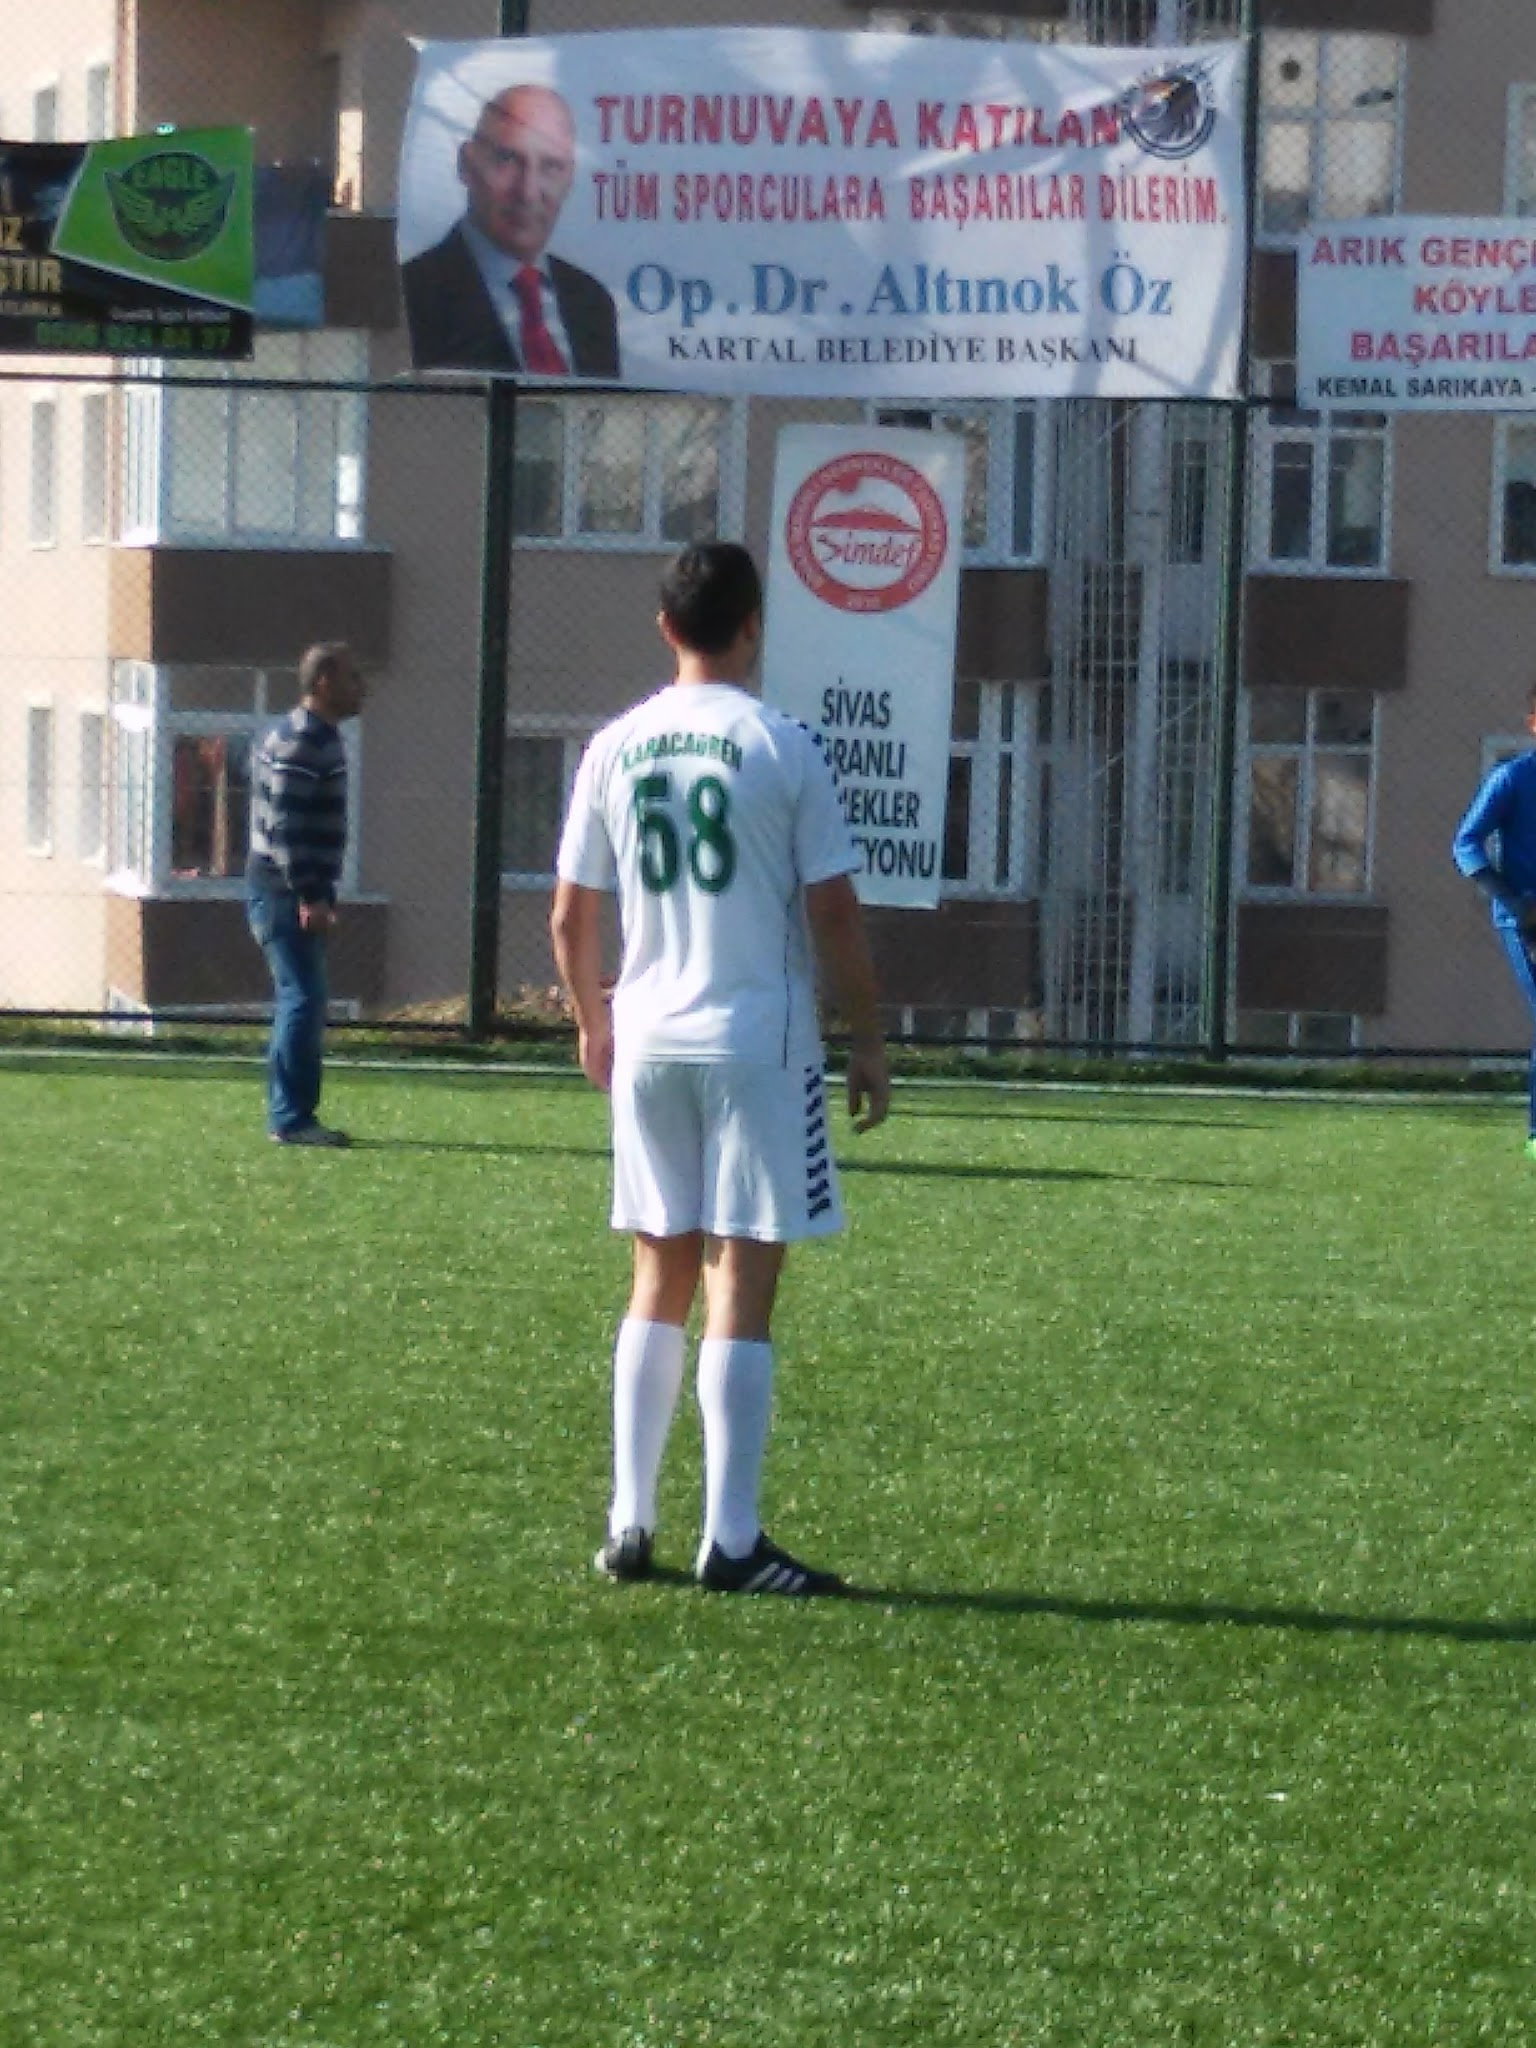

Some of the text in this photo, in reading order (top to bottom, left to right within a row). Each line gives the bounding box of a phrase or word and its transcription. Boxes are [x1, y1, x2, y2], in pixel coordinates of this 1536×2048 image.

[594, 93, 1121, 153] TURNUVAYA KATILAN
[592, 158, 660, 222] TÜM
[674, 172, 888, 222] SPORCULARA
[909, 173, 1087, 231] BAŞARILAR
[1311, 235, 1536, 277] ARIK GENÇ
[1100, 250, 1175, 316] Öz
[667, 333, 1138, 369] KARTAL BELEDİYE BAŞKANI
[1317, 376, 1524, 399] KEMAL SARIKAYA
[821, 676, 892, 730] SİVAS
[825, 737, 905, 780] RANLI
[843, 786, 920, 828] EKLER
[634, 773, 738, 895] 58
